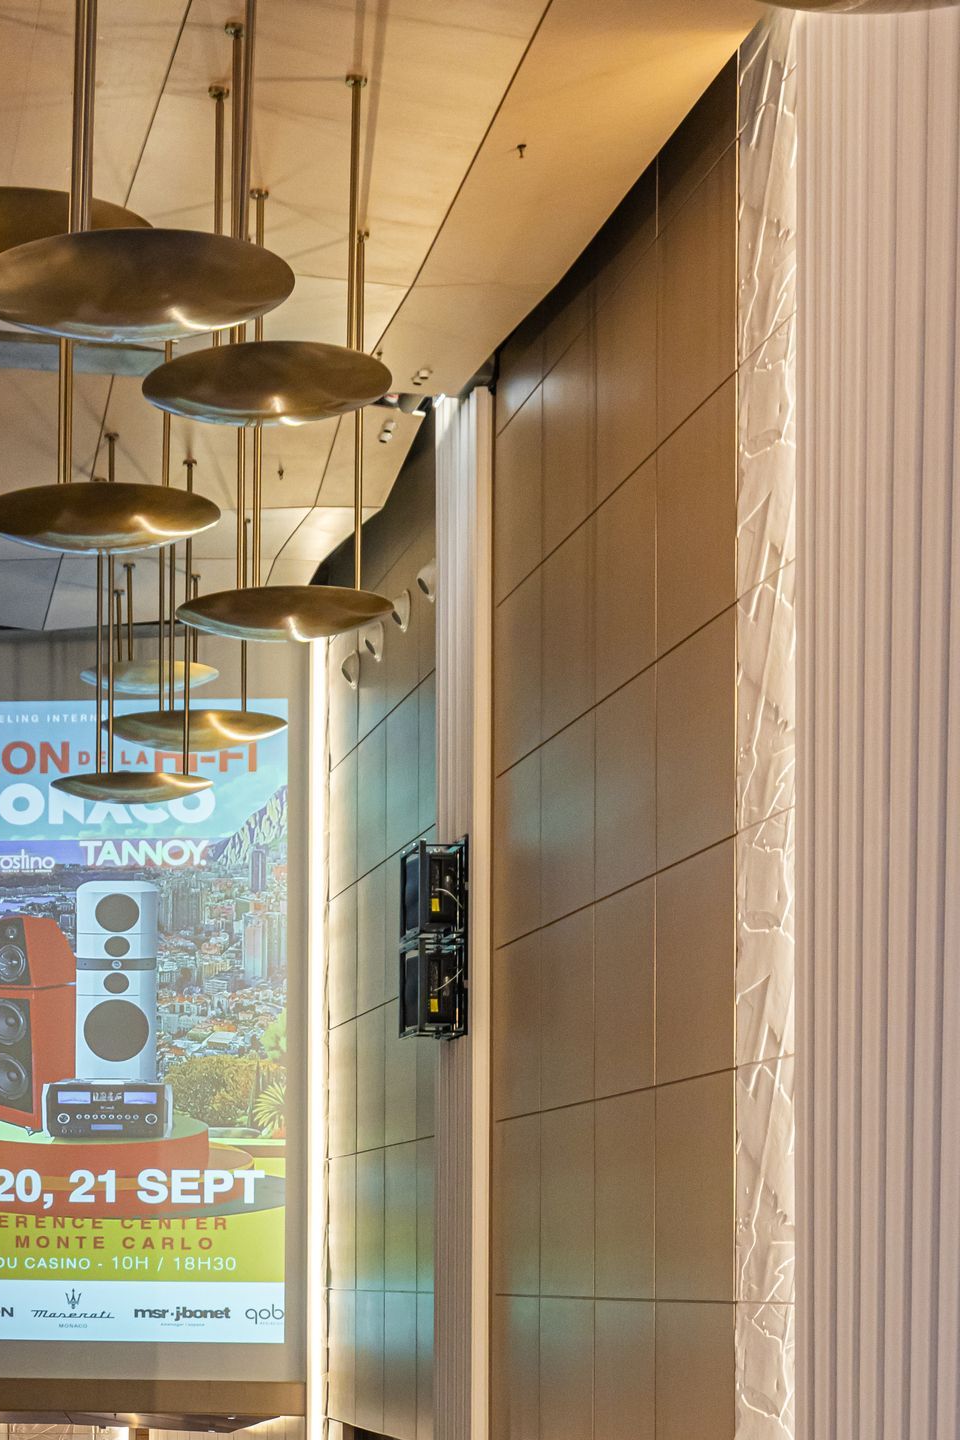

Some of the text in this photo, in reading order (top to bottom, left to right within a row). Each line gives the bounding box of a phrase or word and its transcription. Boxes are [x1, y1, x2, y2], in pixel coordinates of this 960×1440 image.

[121, 751, 148, 765] LA
[68, 1169, 116, 1203] 21
[137, 1169, 265, 1204] SEPT
[121, 1217, 227, 1230] CENTER
[15, 1235, 105, 1249] MONTE
[122, 1236, 213, 1250] CARLO
[24, 1257, 90, 1270] CASINO
[112, 1256, 149, 1270] 10H
[174, 1256, 237, 1271] 18H30
[30, 1309, 115, 1319] Maserati
